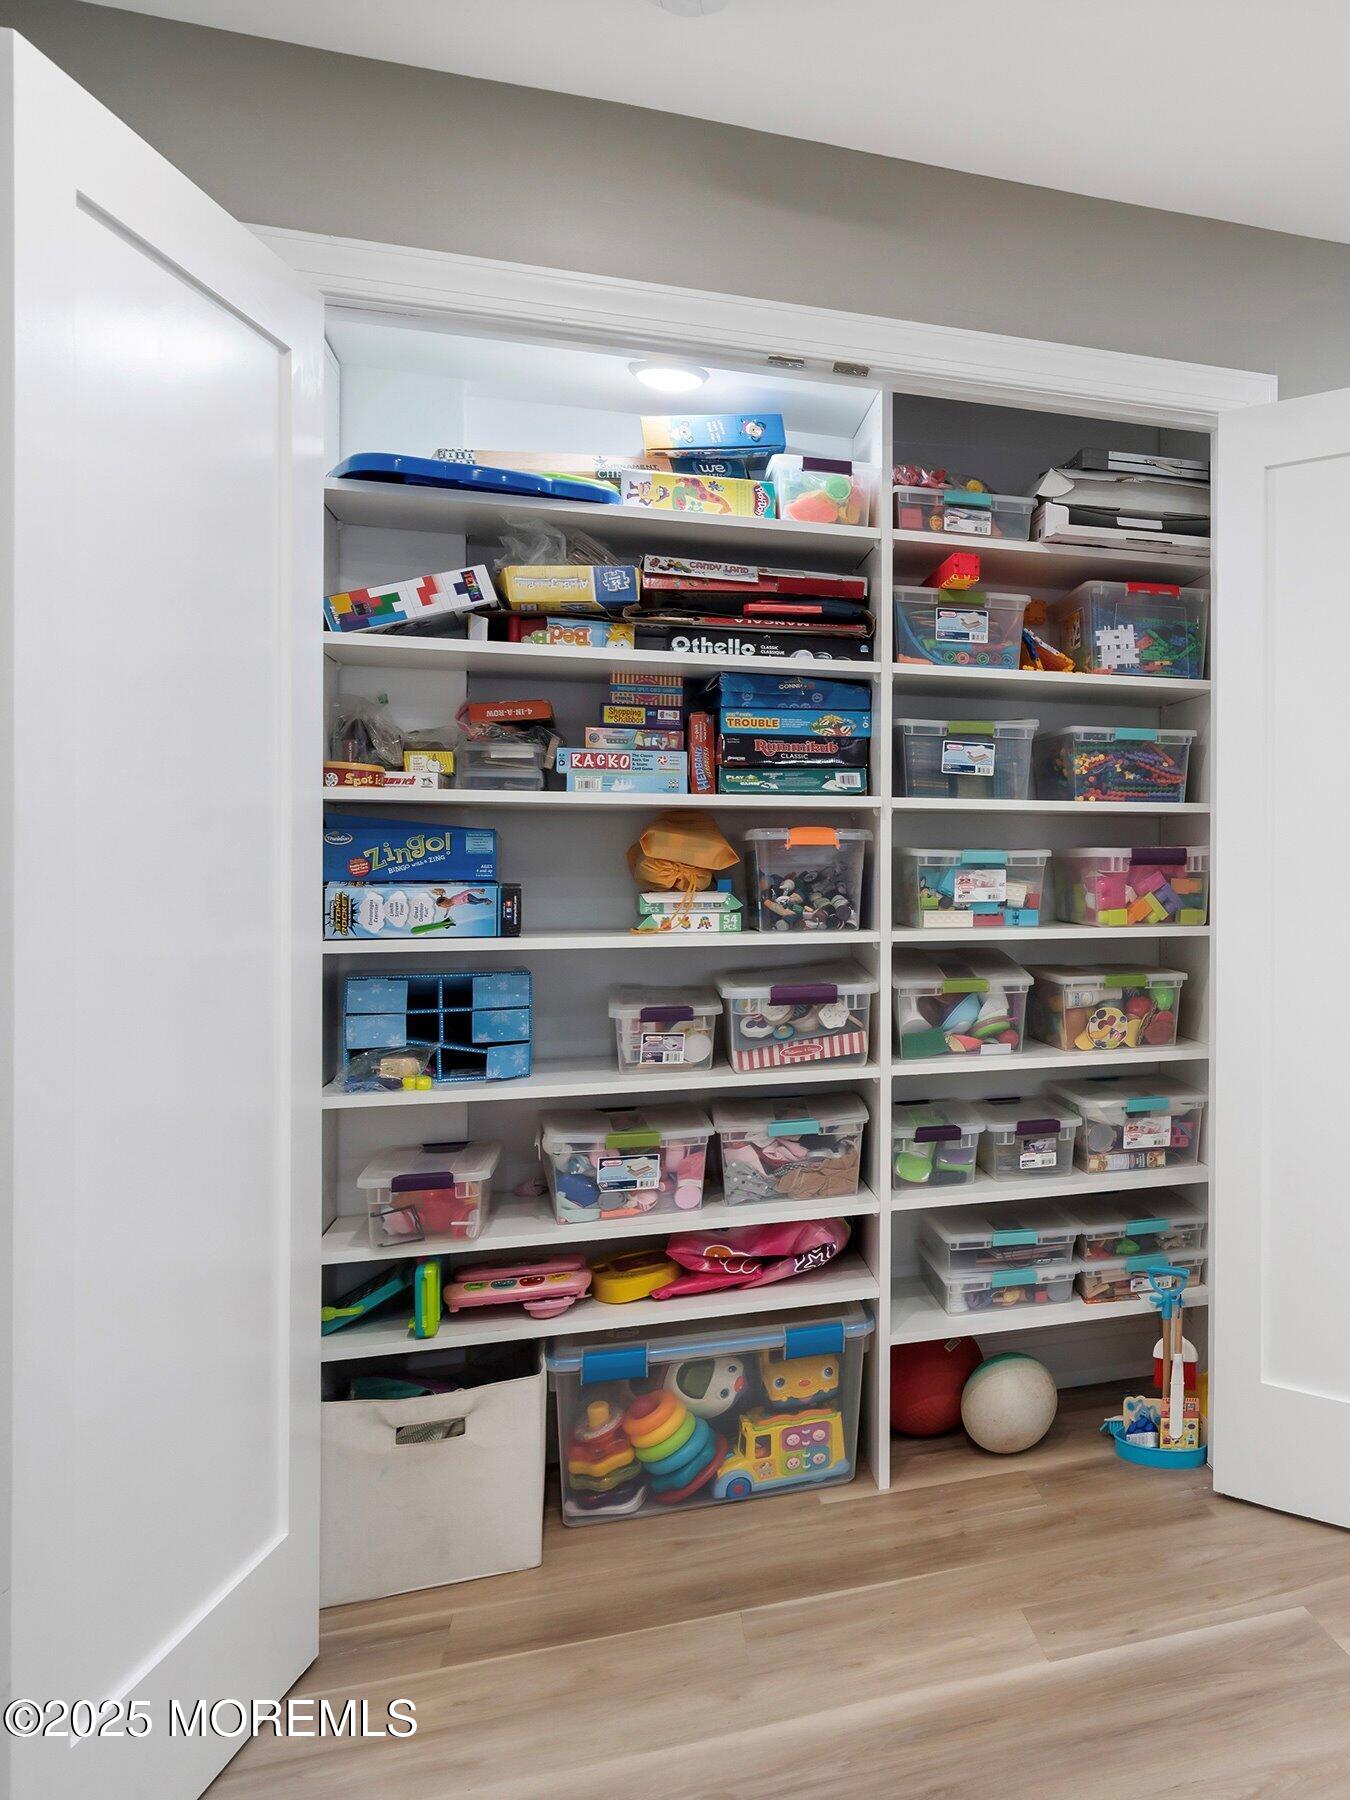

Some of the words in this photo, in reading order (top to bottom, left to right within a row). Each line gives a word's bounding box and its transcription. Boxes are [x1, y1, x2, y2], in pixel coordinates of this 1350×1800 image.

[689, 561, 721, 571] CANDY
[724, 564, 749, 574] LAND
[671, 636, 755, 656] Othello
[608, 706, 642, 717] Shopping
[727, 718, 779, 728] TROUBLE
[754, 739, 839, 757] Rummikub
[694, 745, 710, 791] HEDBANZ
[344, 772, 373, 787] Spot
[363, 832, 452, 871] Zingo!
[387, 864, 411, 875] BINGO
[428, 854, 446, 863] ZING
[723, 915, 738, 923] 54
